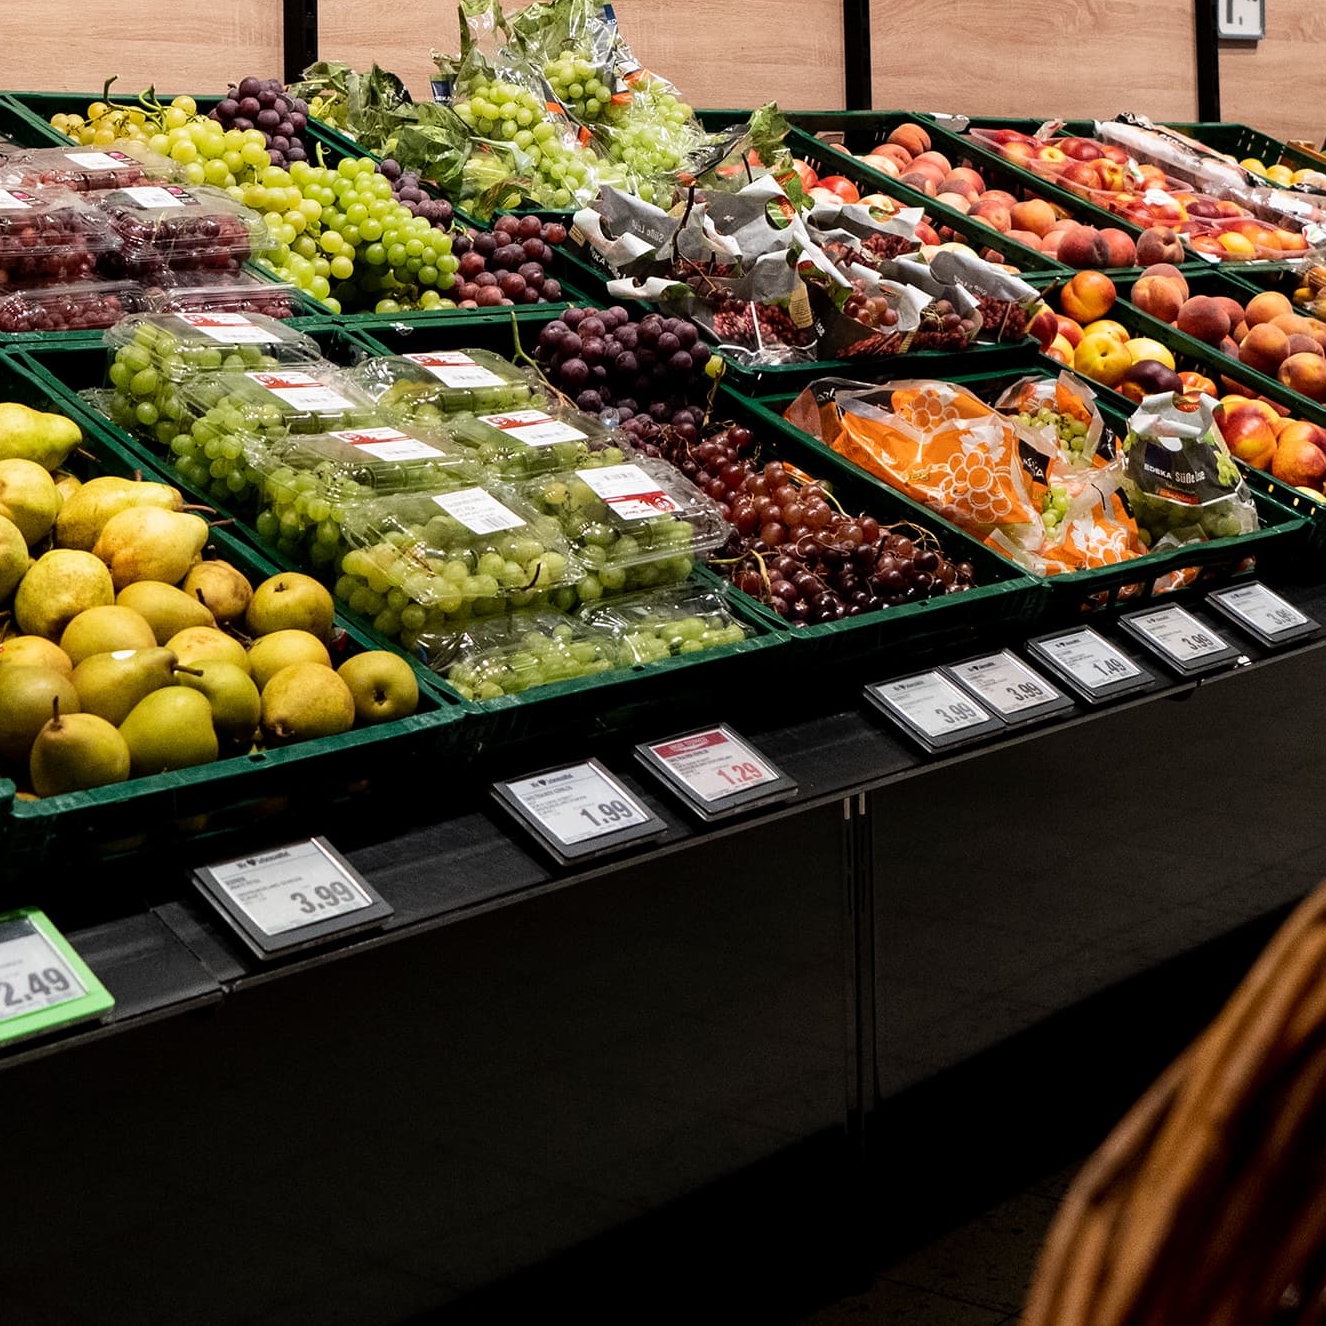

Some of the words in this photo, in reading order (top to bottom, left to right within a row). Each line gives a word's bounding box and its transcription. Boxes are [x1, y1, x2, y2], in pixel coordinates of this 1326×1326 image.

[1144, 462, 1173, 480] EDEKA
[1181, 633, 1214, 651] 3.99
[1093, 658, 1125, 676] 1.49
[1006, 681, 1044, 701] 3.99
[935, 702, 976, 724] 3.99
[716, 761, 763, 785] 1.29
[580, 800, 633, 827] 1.99
[290, 881, 355, 914] 3.99
